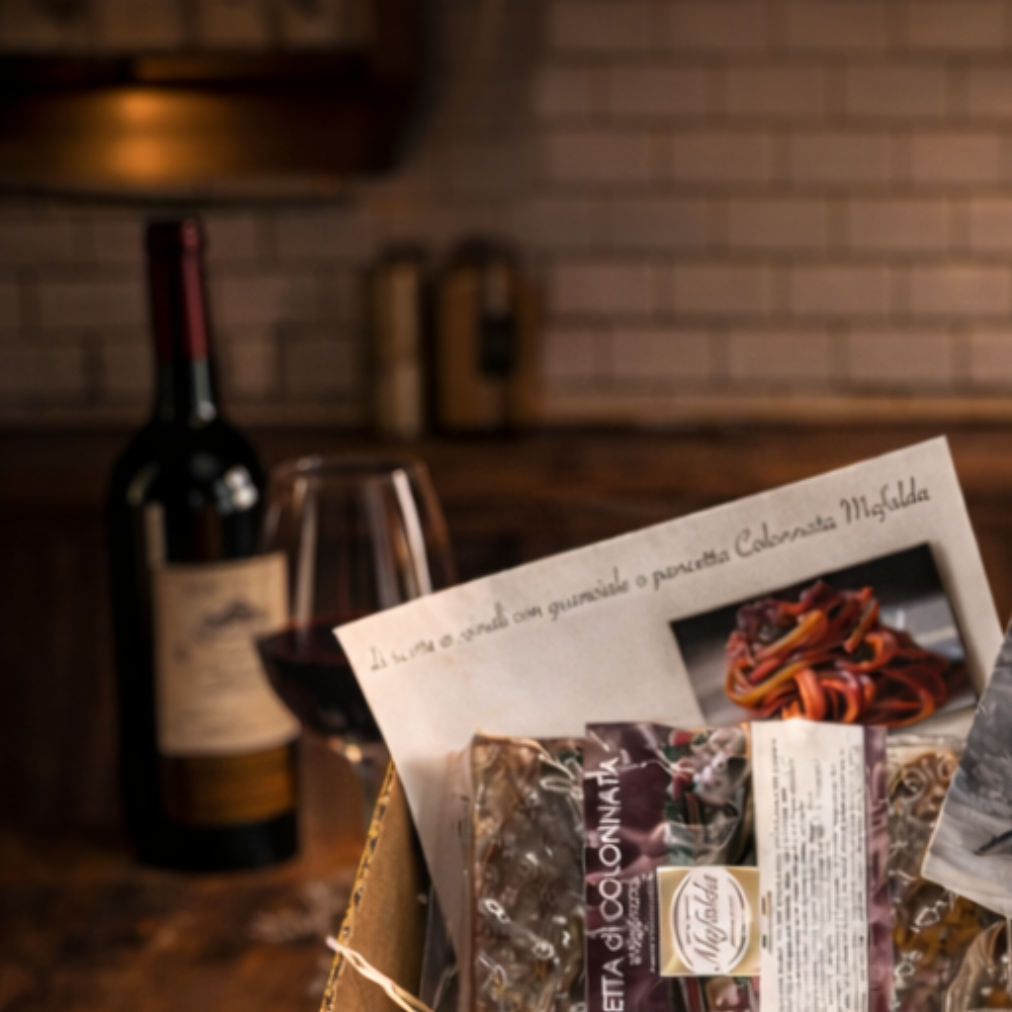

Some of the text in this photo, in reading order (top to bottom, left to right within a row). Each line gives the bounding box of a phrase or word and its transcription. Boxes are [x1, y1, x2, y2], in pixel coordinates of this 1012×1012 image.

[652, 548, 730, 590] pancetta
[734, 521, 837, 558] Colonnata
[598, 756, 623, 921] COLONNATA
